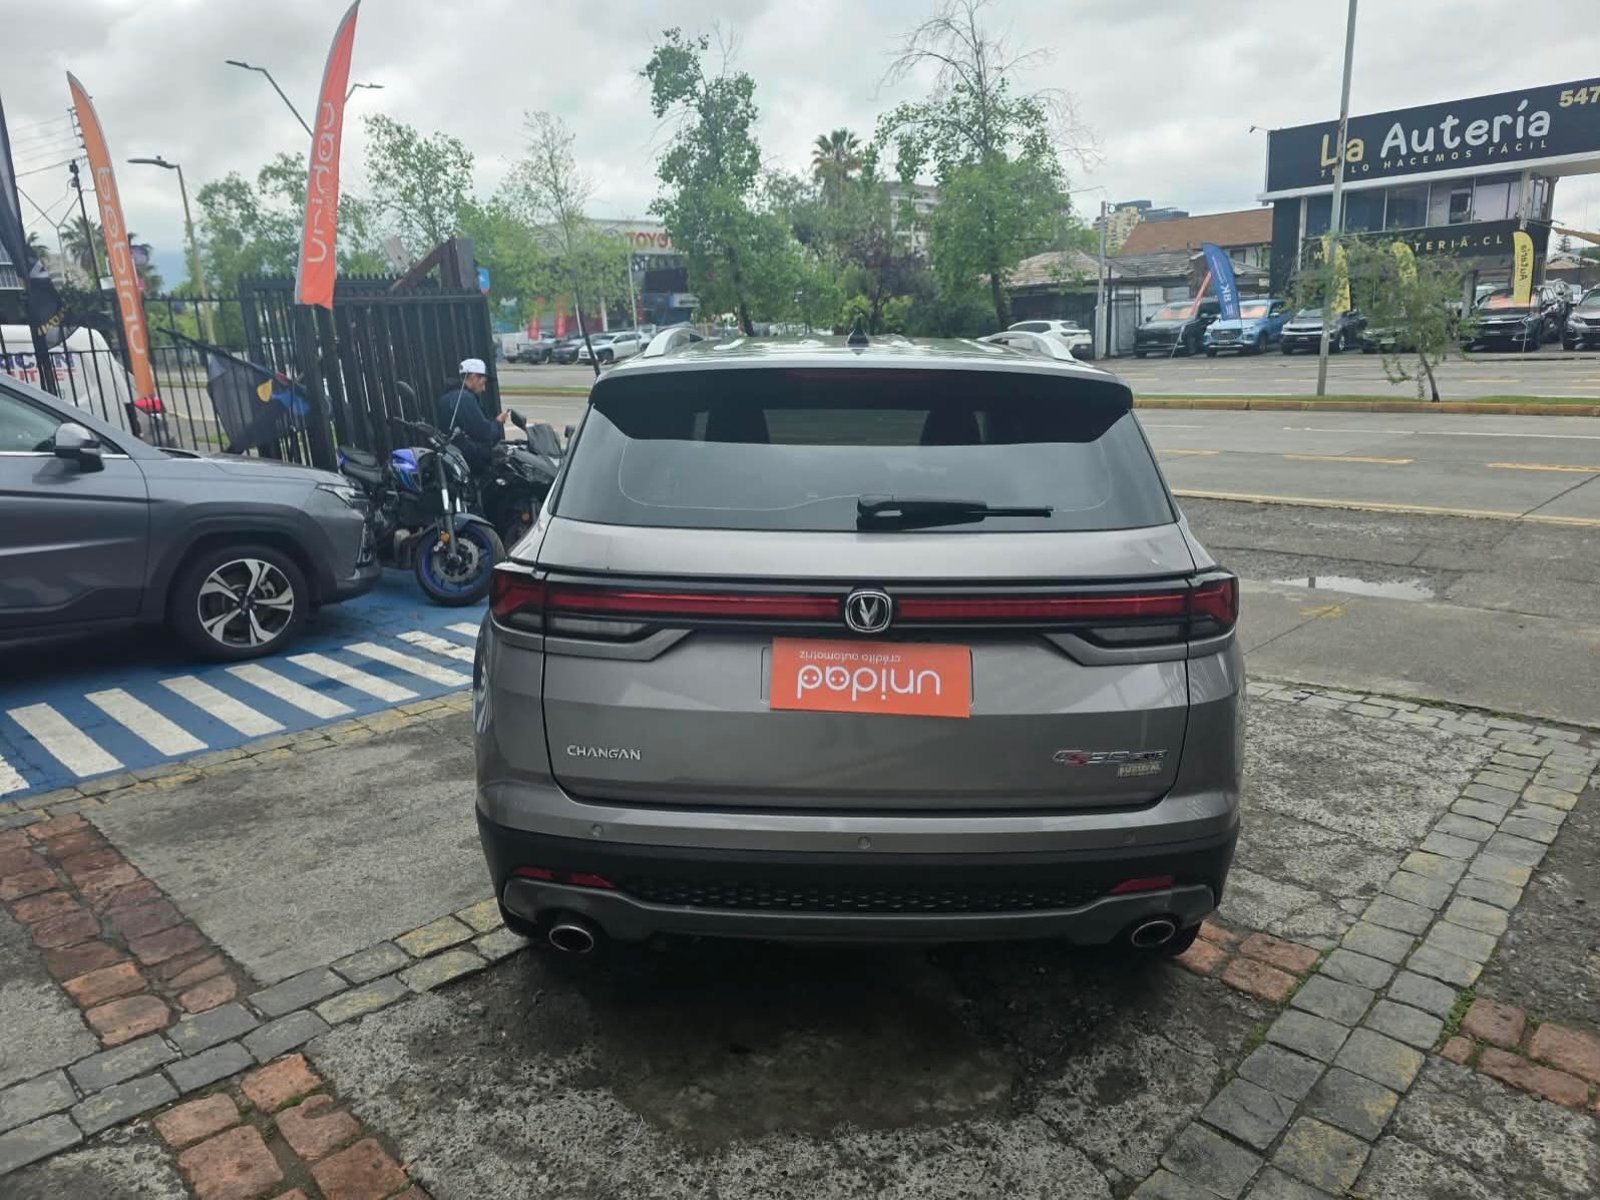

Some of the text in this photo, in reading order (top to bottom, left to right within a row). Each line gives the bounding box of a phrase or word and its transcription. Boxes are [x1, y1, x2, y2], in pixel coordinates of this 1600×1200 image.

[1320, 99, 1551, 168] La Autería
[1351, 165, 1369, 174] LO
[1384, 150, 1472, 169] HACEMOS
[1488, 141, 1548, 156] FÁCIL
[624, 231, 672, 249] TOYO
[800, 650, 901, 663] crédito automotriz
[797, 664, 941, 702] unidad
[567, 744, 641, 761] CHANGAN
